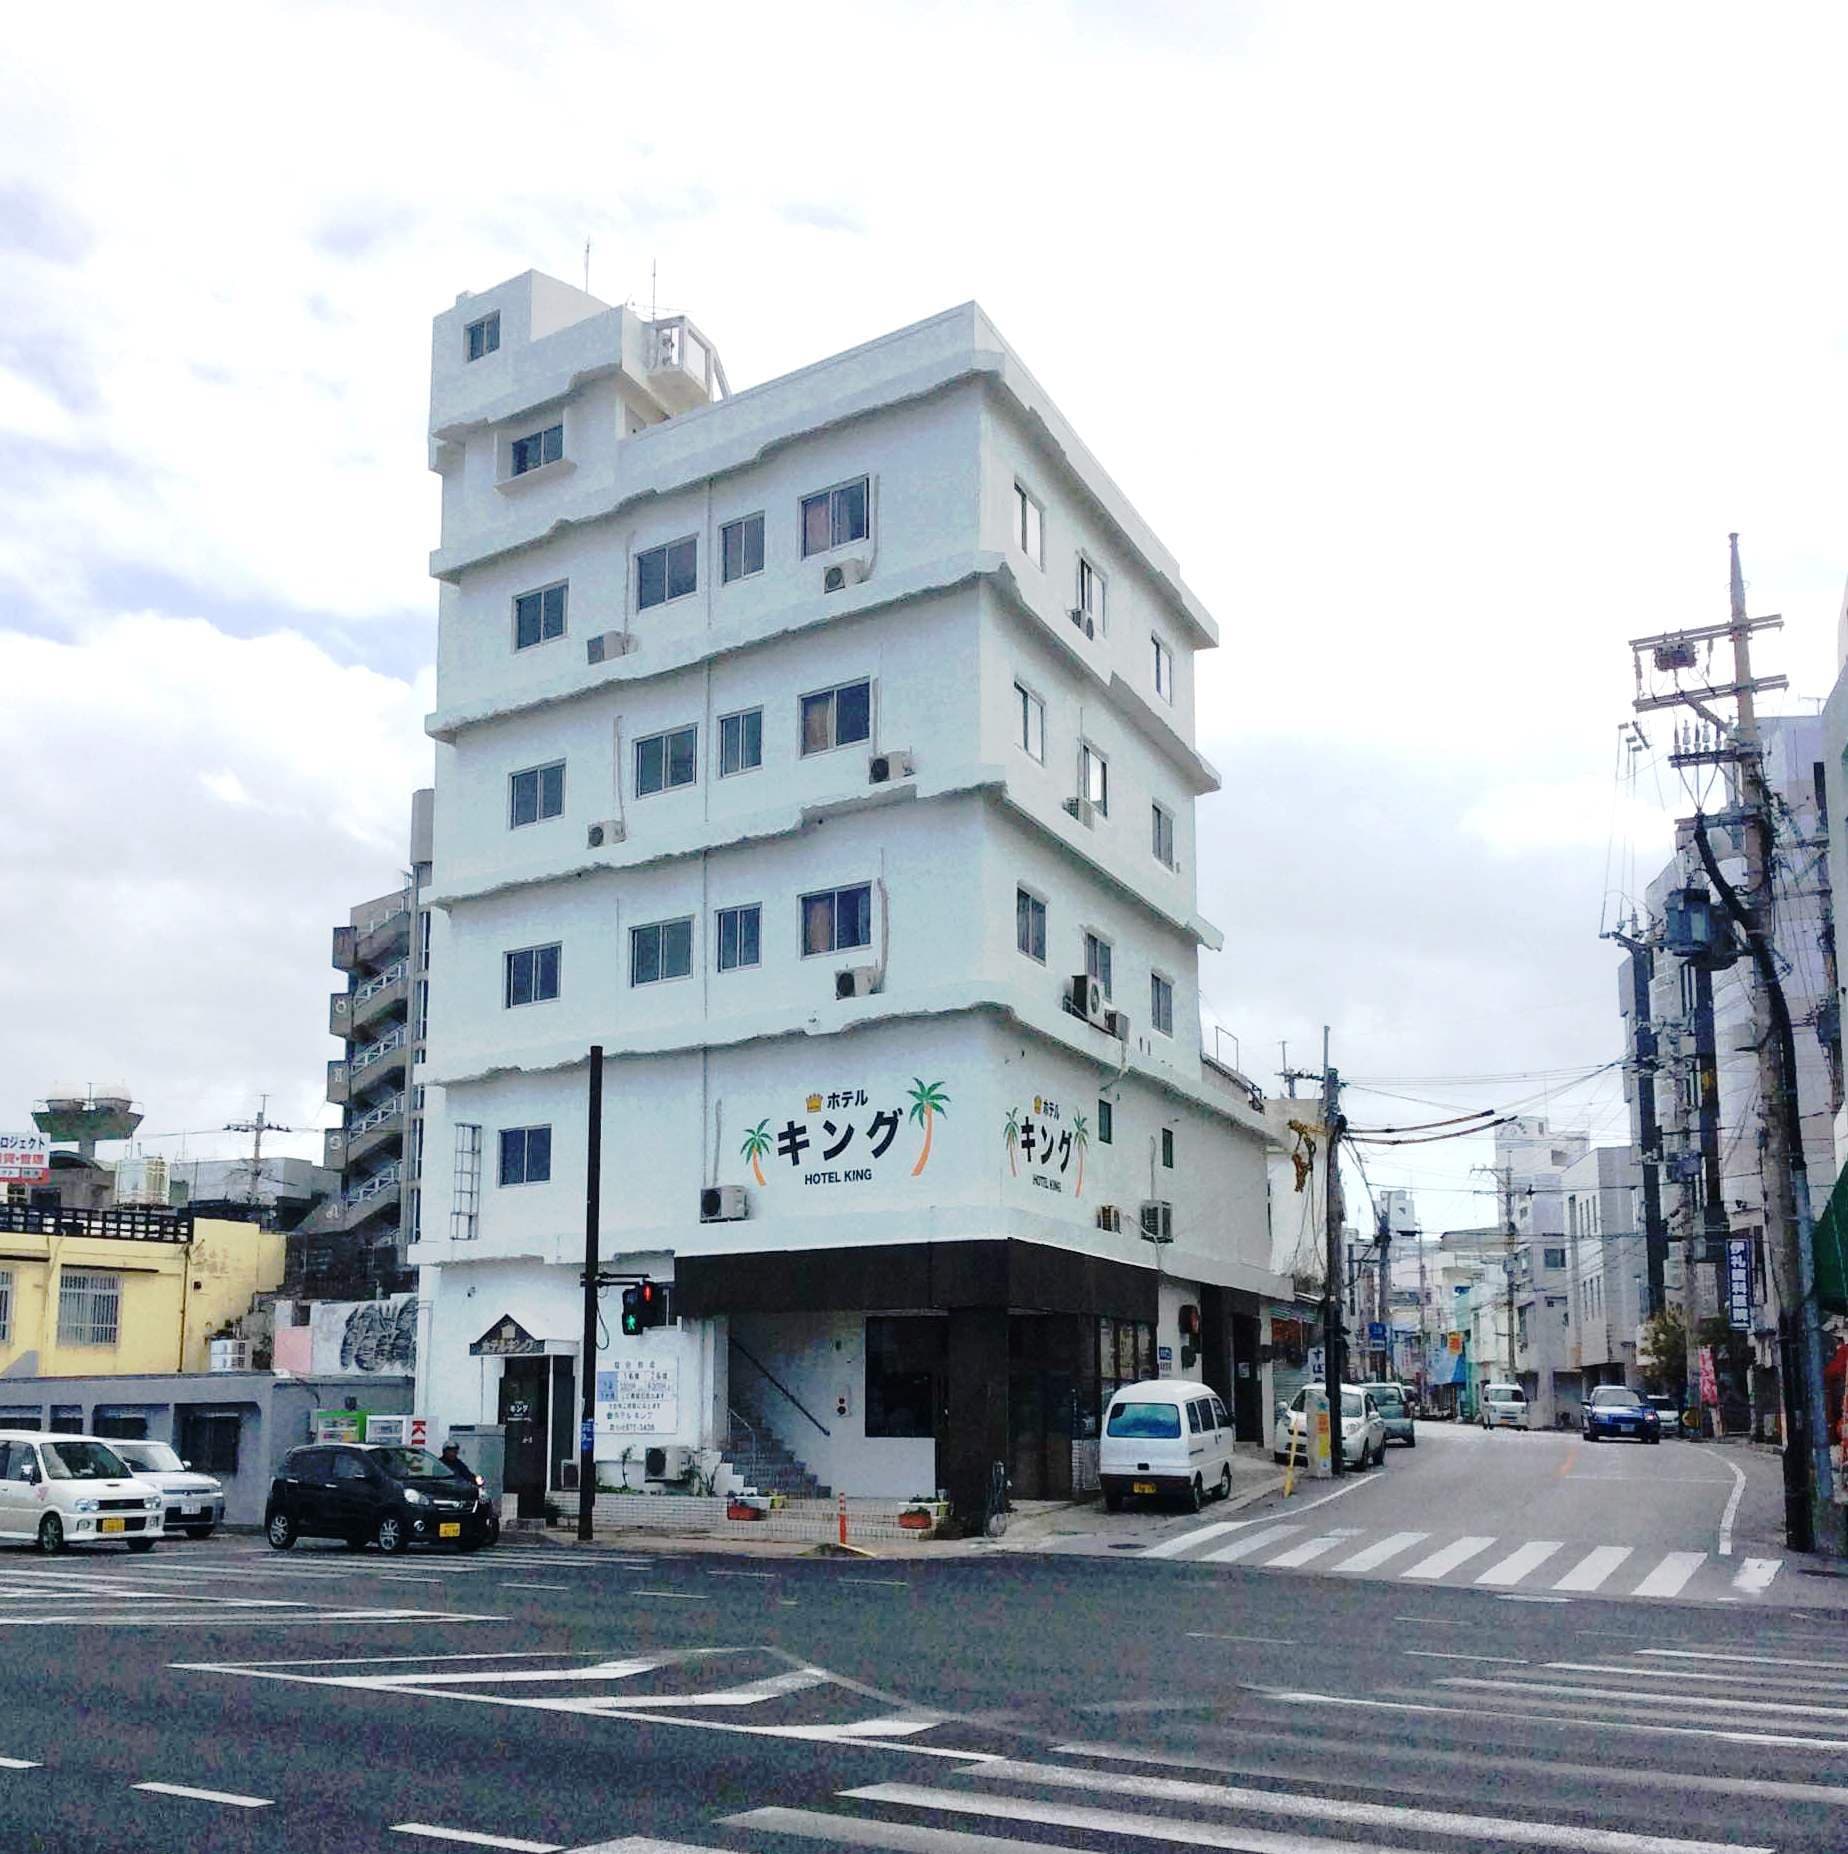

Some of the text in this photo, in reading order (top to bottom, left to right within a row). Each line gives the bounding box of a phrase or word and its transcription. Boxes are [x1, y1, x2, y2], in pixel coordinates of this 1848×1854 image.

[827, 1089, 868, 1110] ホテル
[1043, 1099, 1060, 1121] ホテル
[778, 1108, 903, 1166] キング
[1021, 1116, 1073, 1174] キング
[805, 1168, 873, 1185] HOTEL KING
